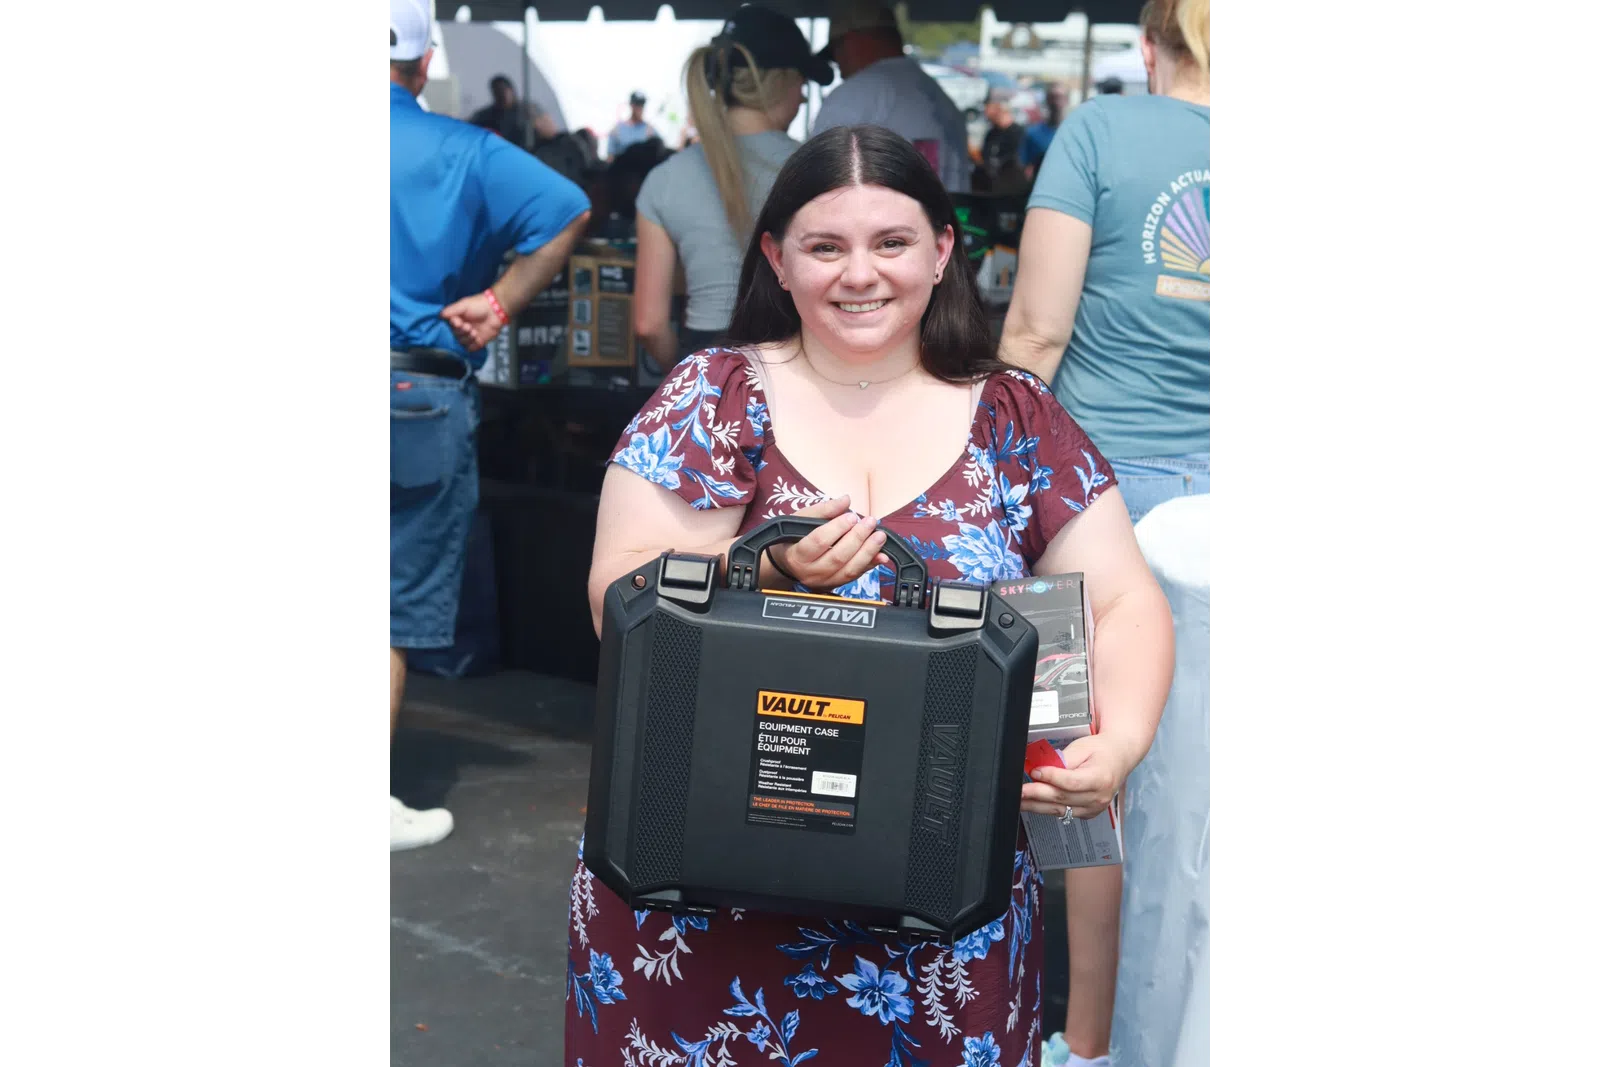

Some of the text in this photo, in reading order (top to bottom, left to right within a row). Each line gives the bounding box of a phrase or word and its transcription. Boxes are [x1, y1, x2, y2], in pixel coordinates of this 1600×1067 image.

[1141, 192, 1171, 264] HORIZON
[792, 605, 869, 624] VAULT
[762, 695, 831, 717] VAULT
[759, 721, 839, 737] EQUIPMENT CASE
[757, 741, 811, 756] ÉQUIPMENT
[758, 732, 807, 746] ÉTUI POUR
[920, 724, 960, 846] VAULT
